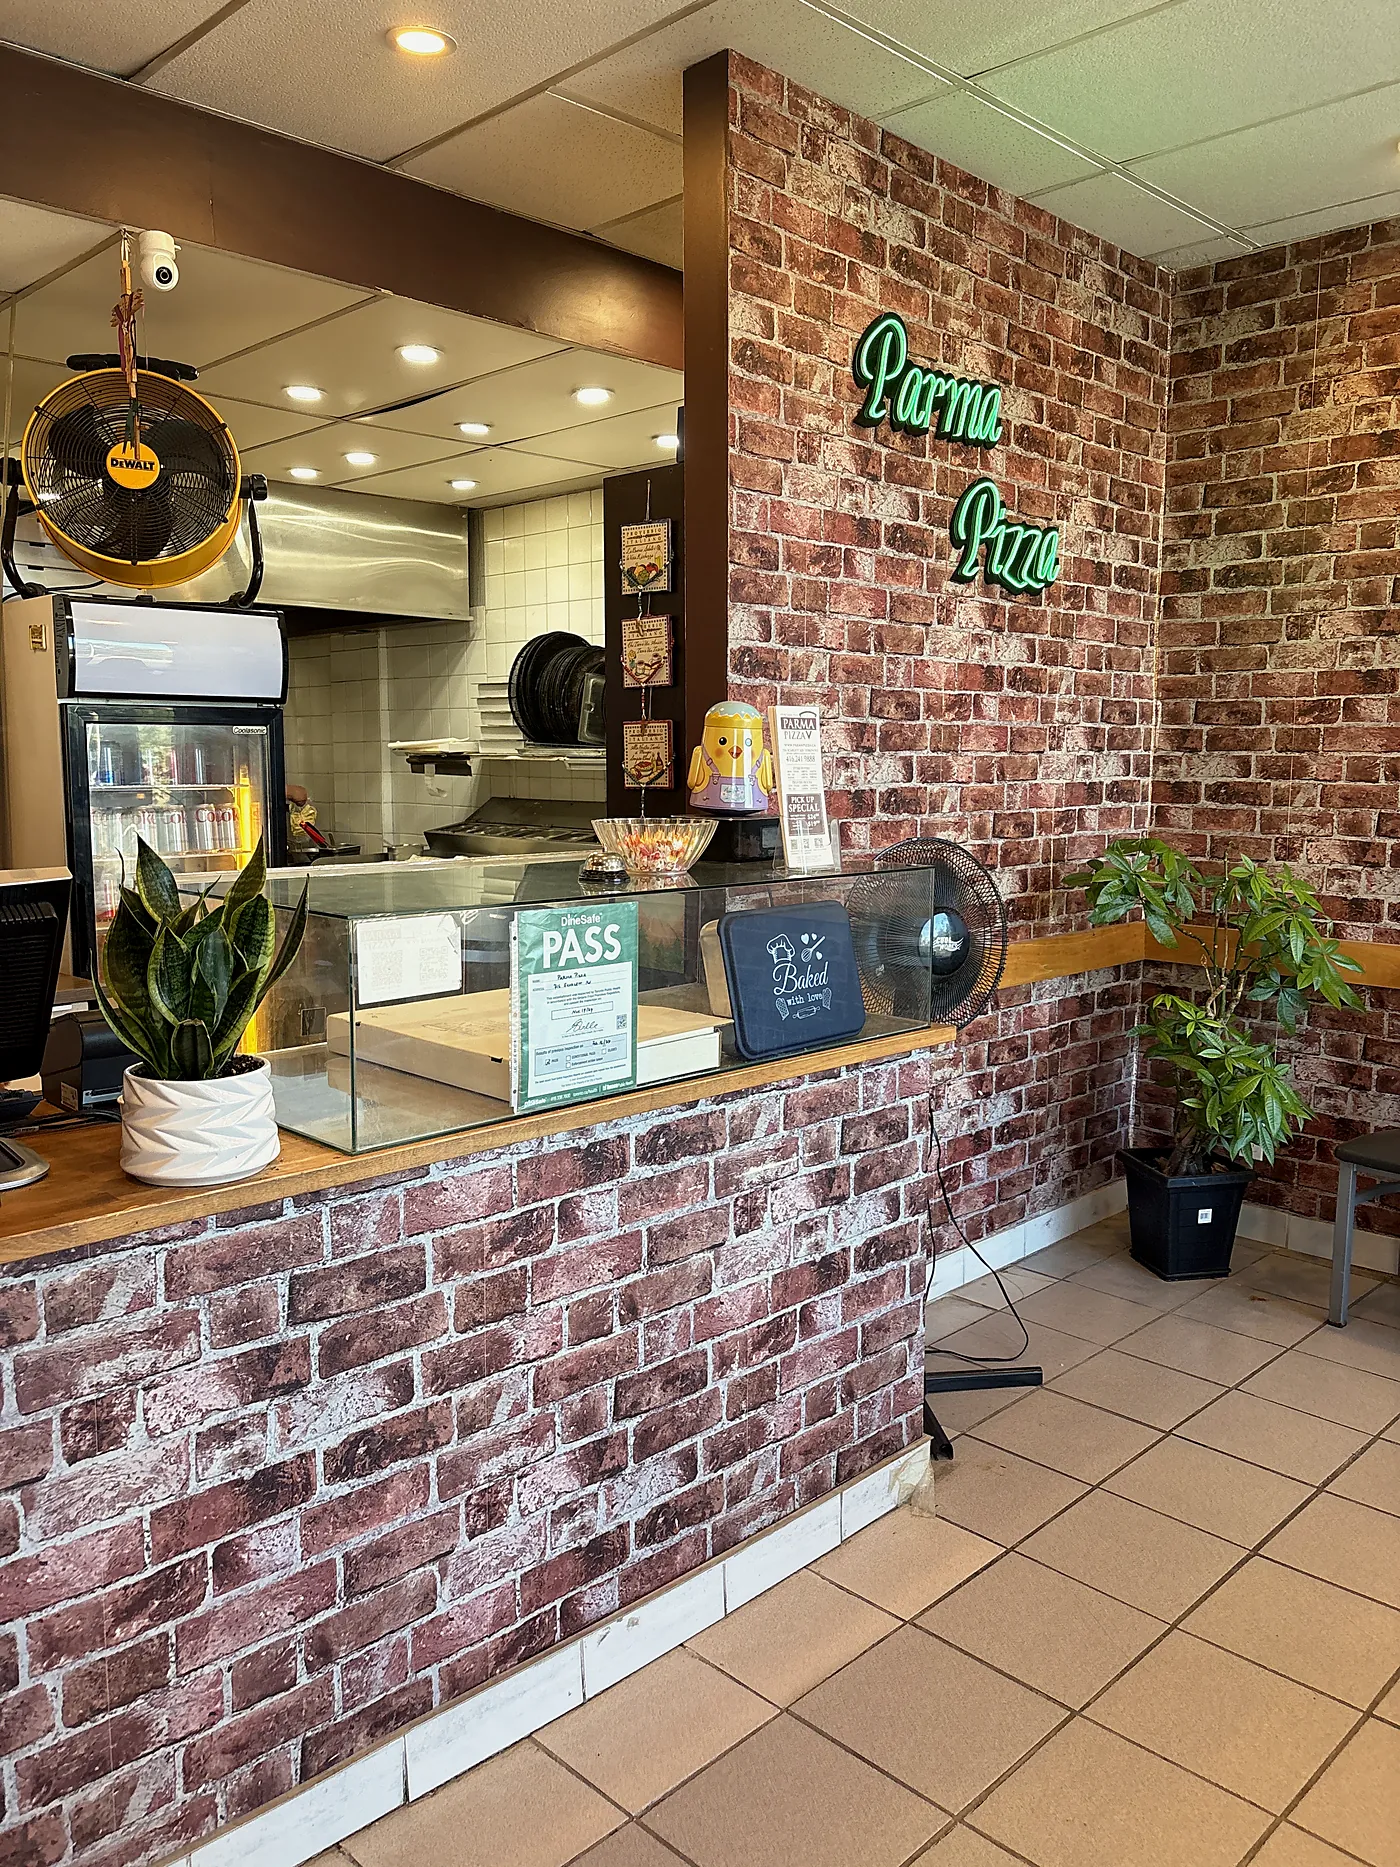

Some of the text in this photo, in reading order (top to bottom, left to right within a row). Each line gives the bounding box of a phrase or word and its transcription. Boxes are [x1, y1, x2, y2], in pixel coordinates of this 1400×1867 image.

[856, 316, 1003, 444] Parma
[955, 479, 1060, 591] Pizza
[783, 718, 815, 730] PARMA
[788, 803, 820, 812] SPECIAL
[543, 924, 622, 968] PASS
[773, 962, 828, 995] Baked
[786, 992, 823, 1006] with love
